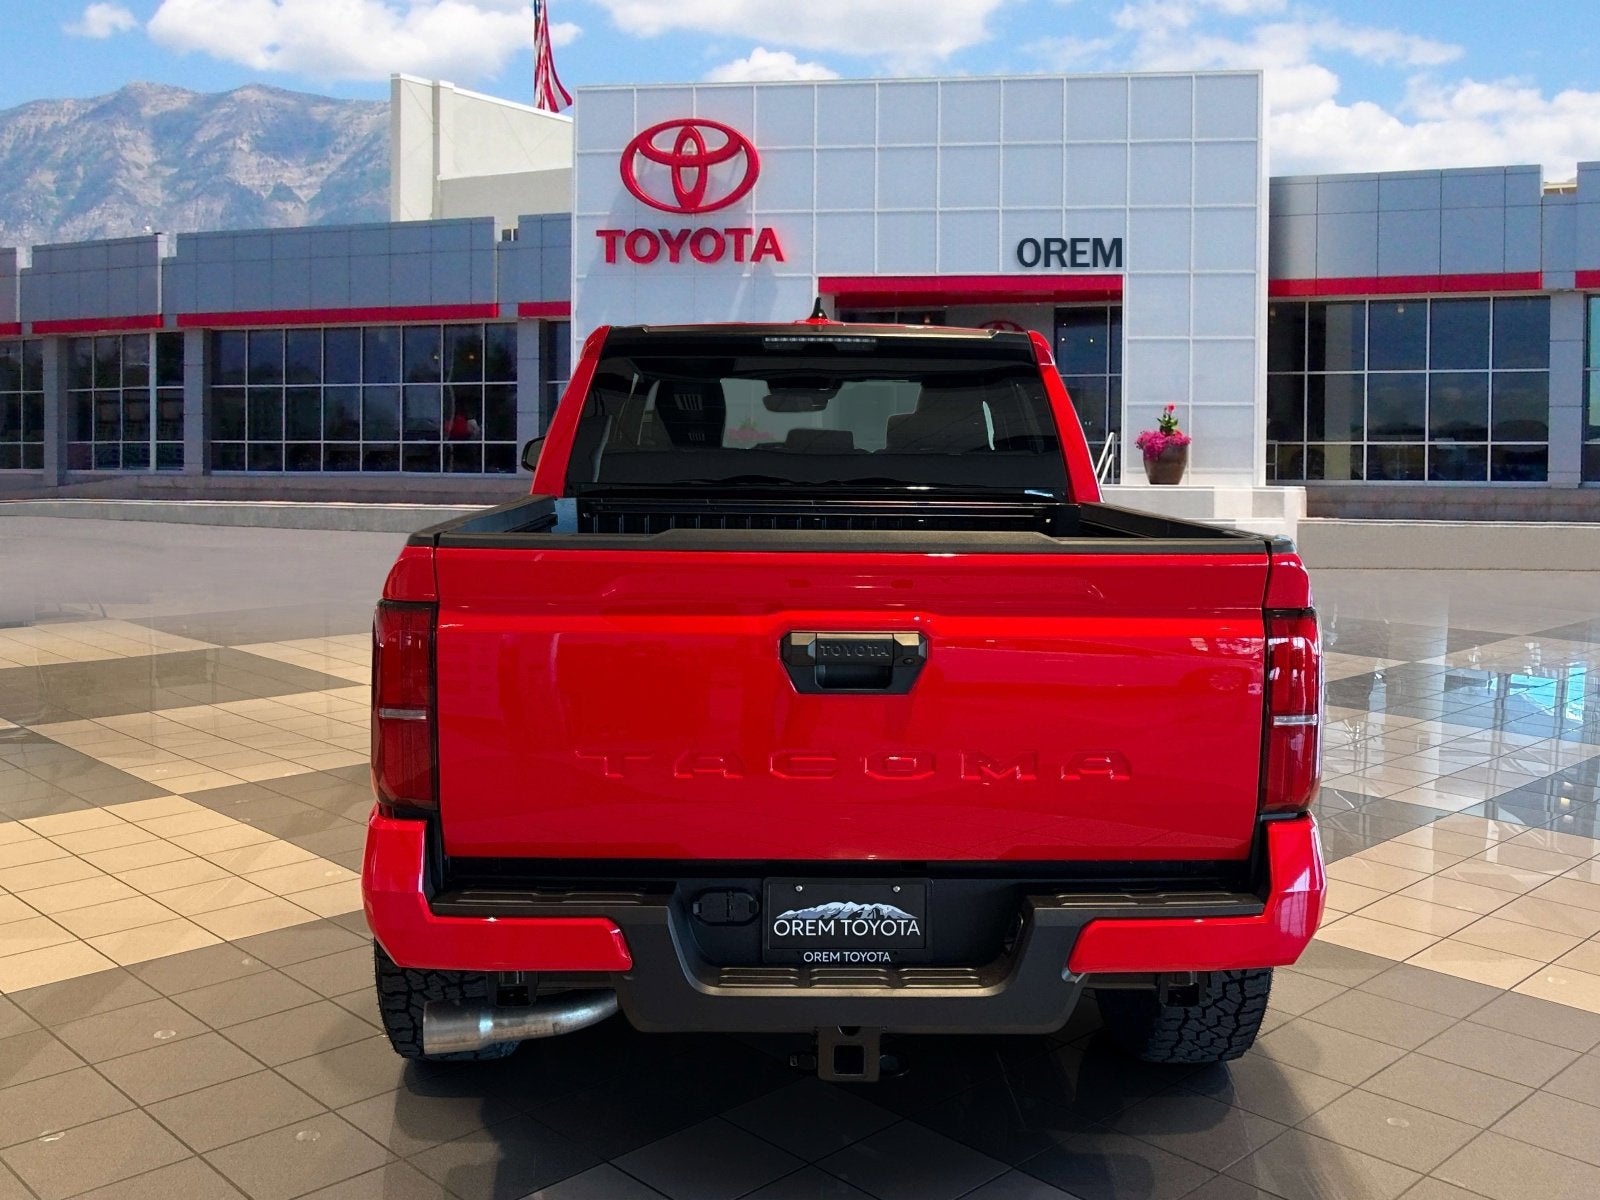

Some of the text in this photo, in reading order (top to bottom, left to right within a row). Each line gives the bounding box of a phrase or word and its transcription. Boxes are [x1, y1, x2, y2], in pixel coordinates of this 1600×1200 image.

[596, 227, 785, 264] TOYOTA
[1016, 237, 1123, 268] OREM
[820, 644, 890, 657] TOYOTA
[574, 749, 1132, 781] TACOMA
[773, 919, 921, 936] OREM TOYOTA
[803, 951, 891, 962] OREM TOYOTA
